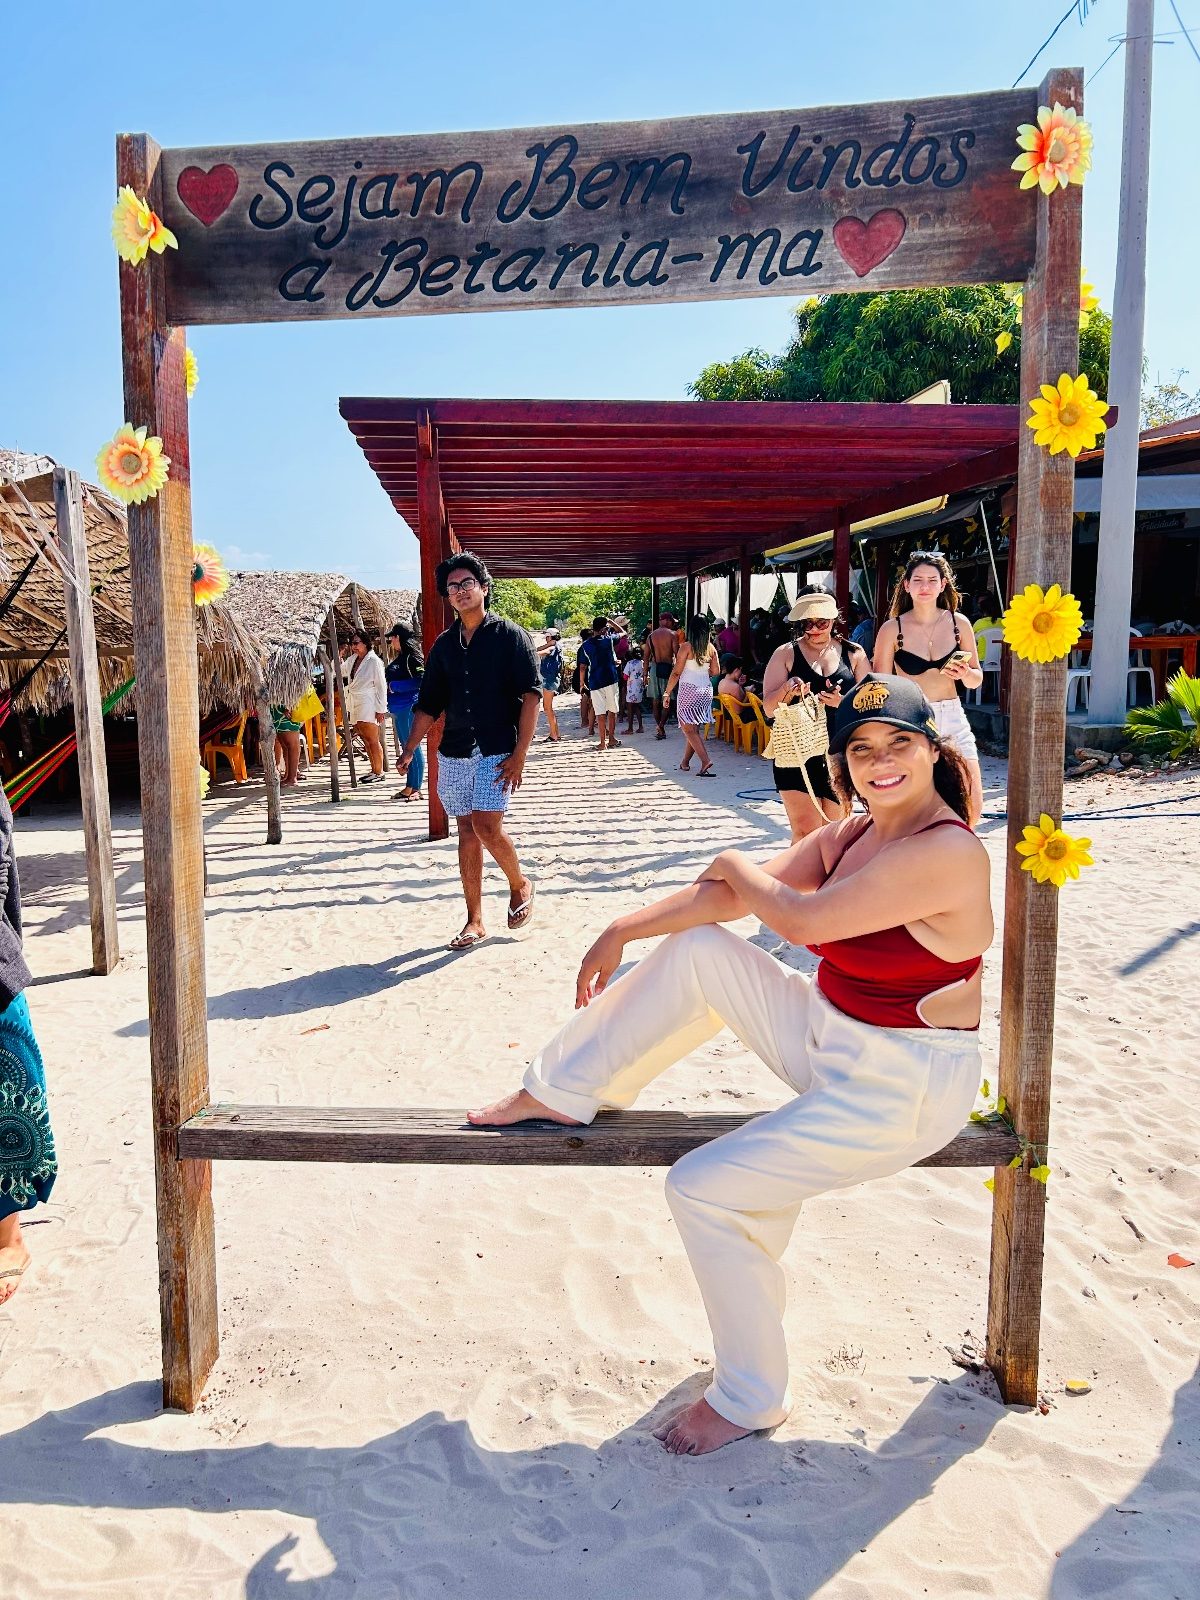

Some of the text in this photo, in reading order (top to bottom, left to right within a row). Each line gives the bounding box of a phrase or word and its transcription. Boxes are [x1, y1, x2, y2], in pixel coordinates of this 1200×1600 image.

[249, 113, 975, 249] Sejam Bem Vindos
[278, 228, 823, 311] a Betania-ma
